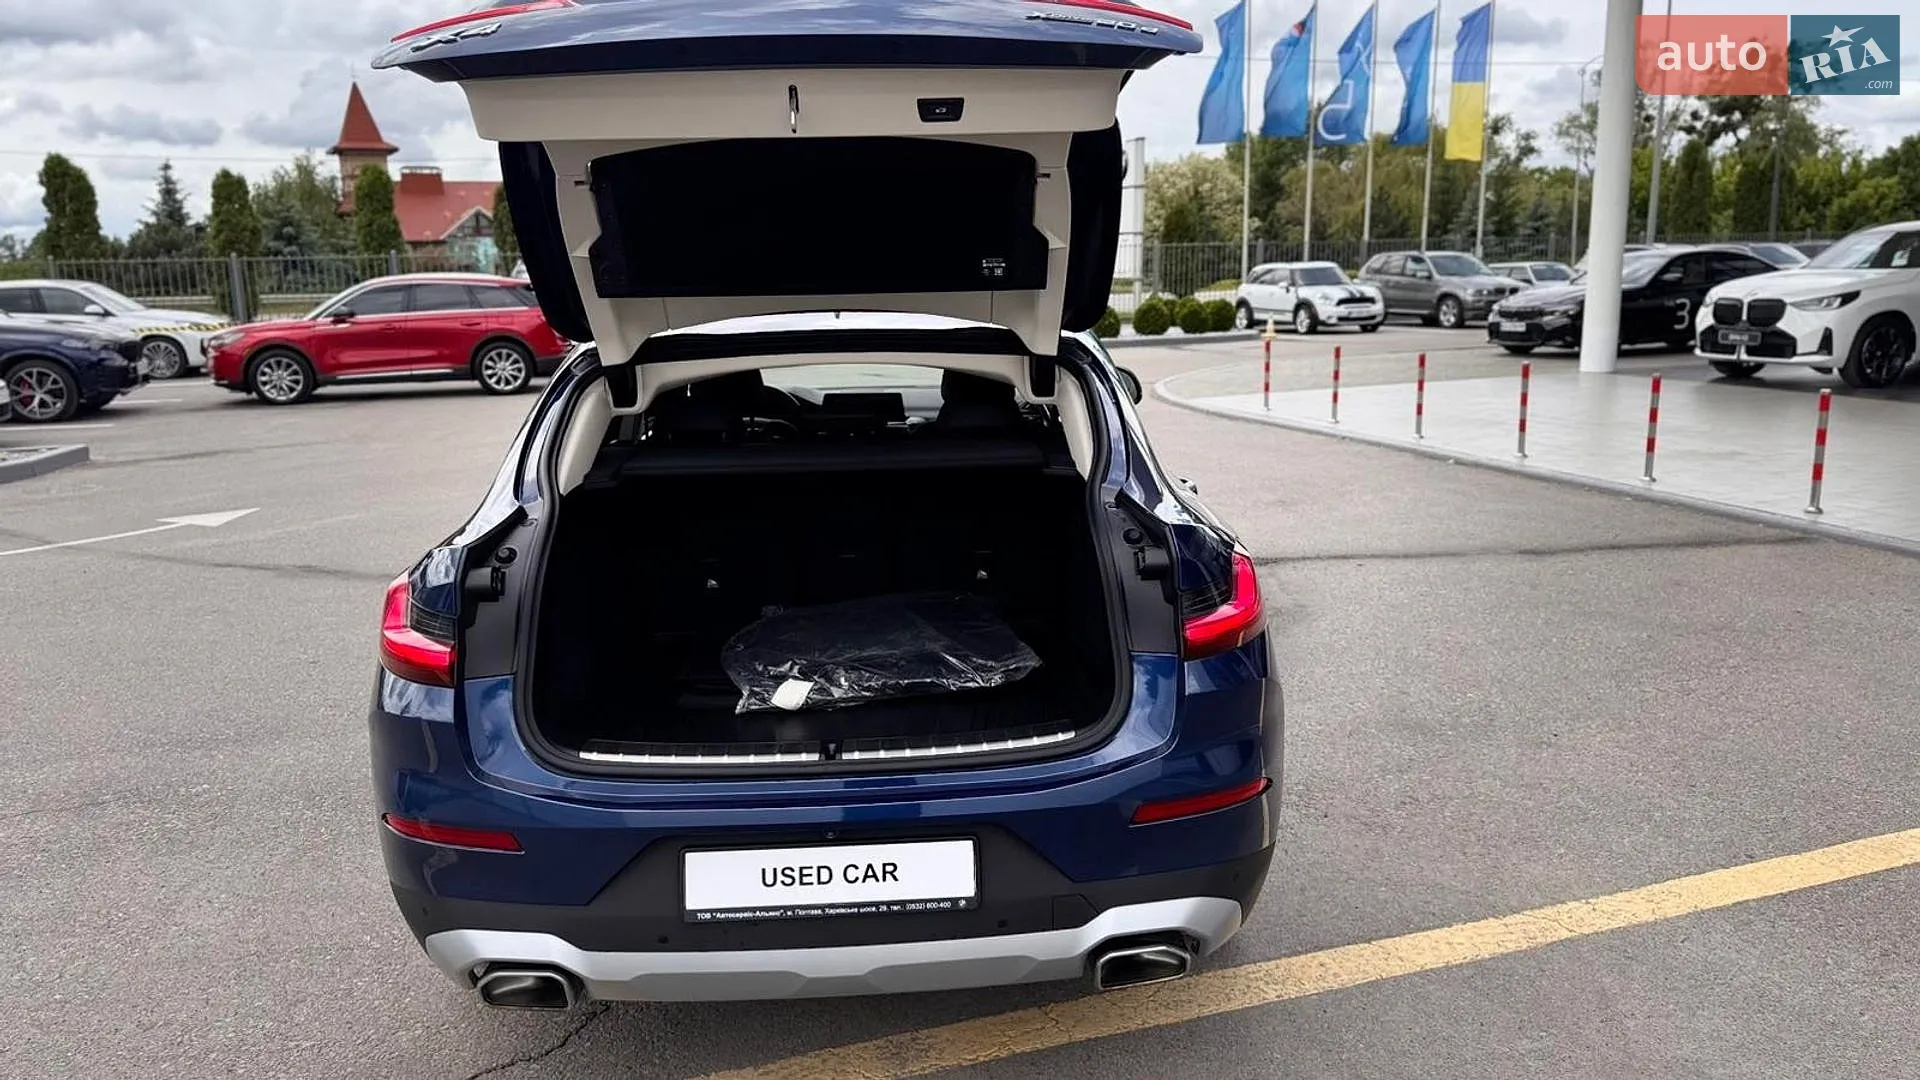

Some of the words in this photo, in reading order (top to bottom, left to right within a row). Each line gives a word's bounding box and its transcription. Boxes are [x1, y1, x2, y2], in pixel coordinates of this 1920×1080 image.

[1673, 298, 1690, 330] 3
[761, 865, 833, 887] USED
[843, 862, 899, 884] CAR
